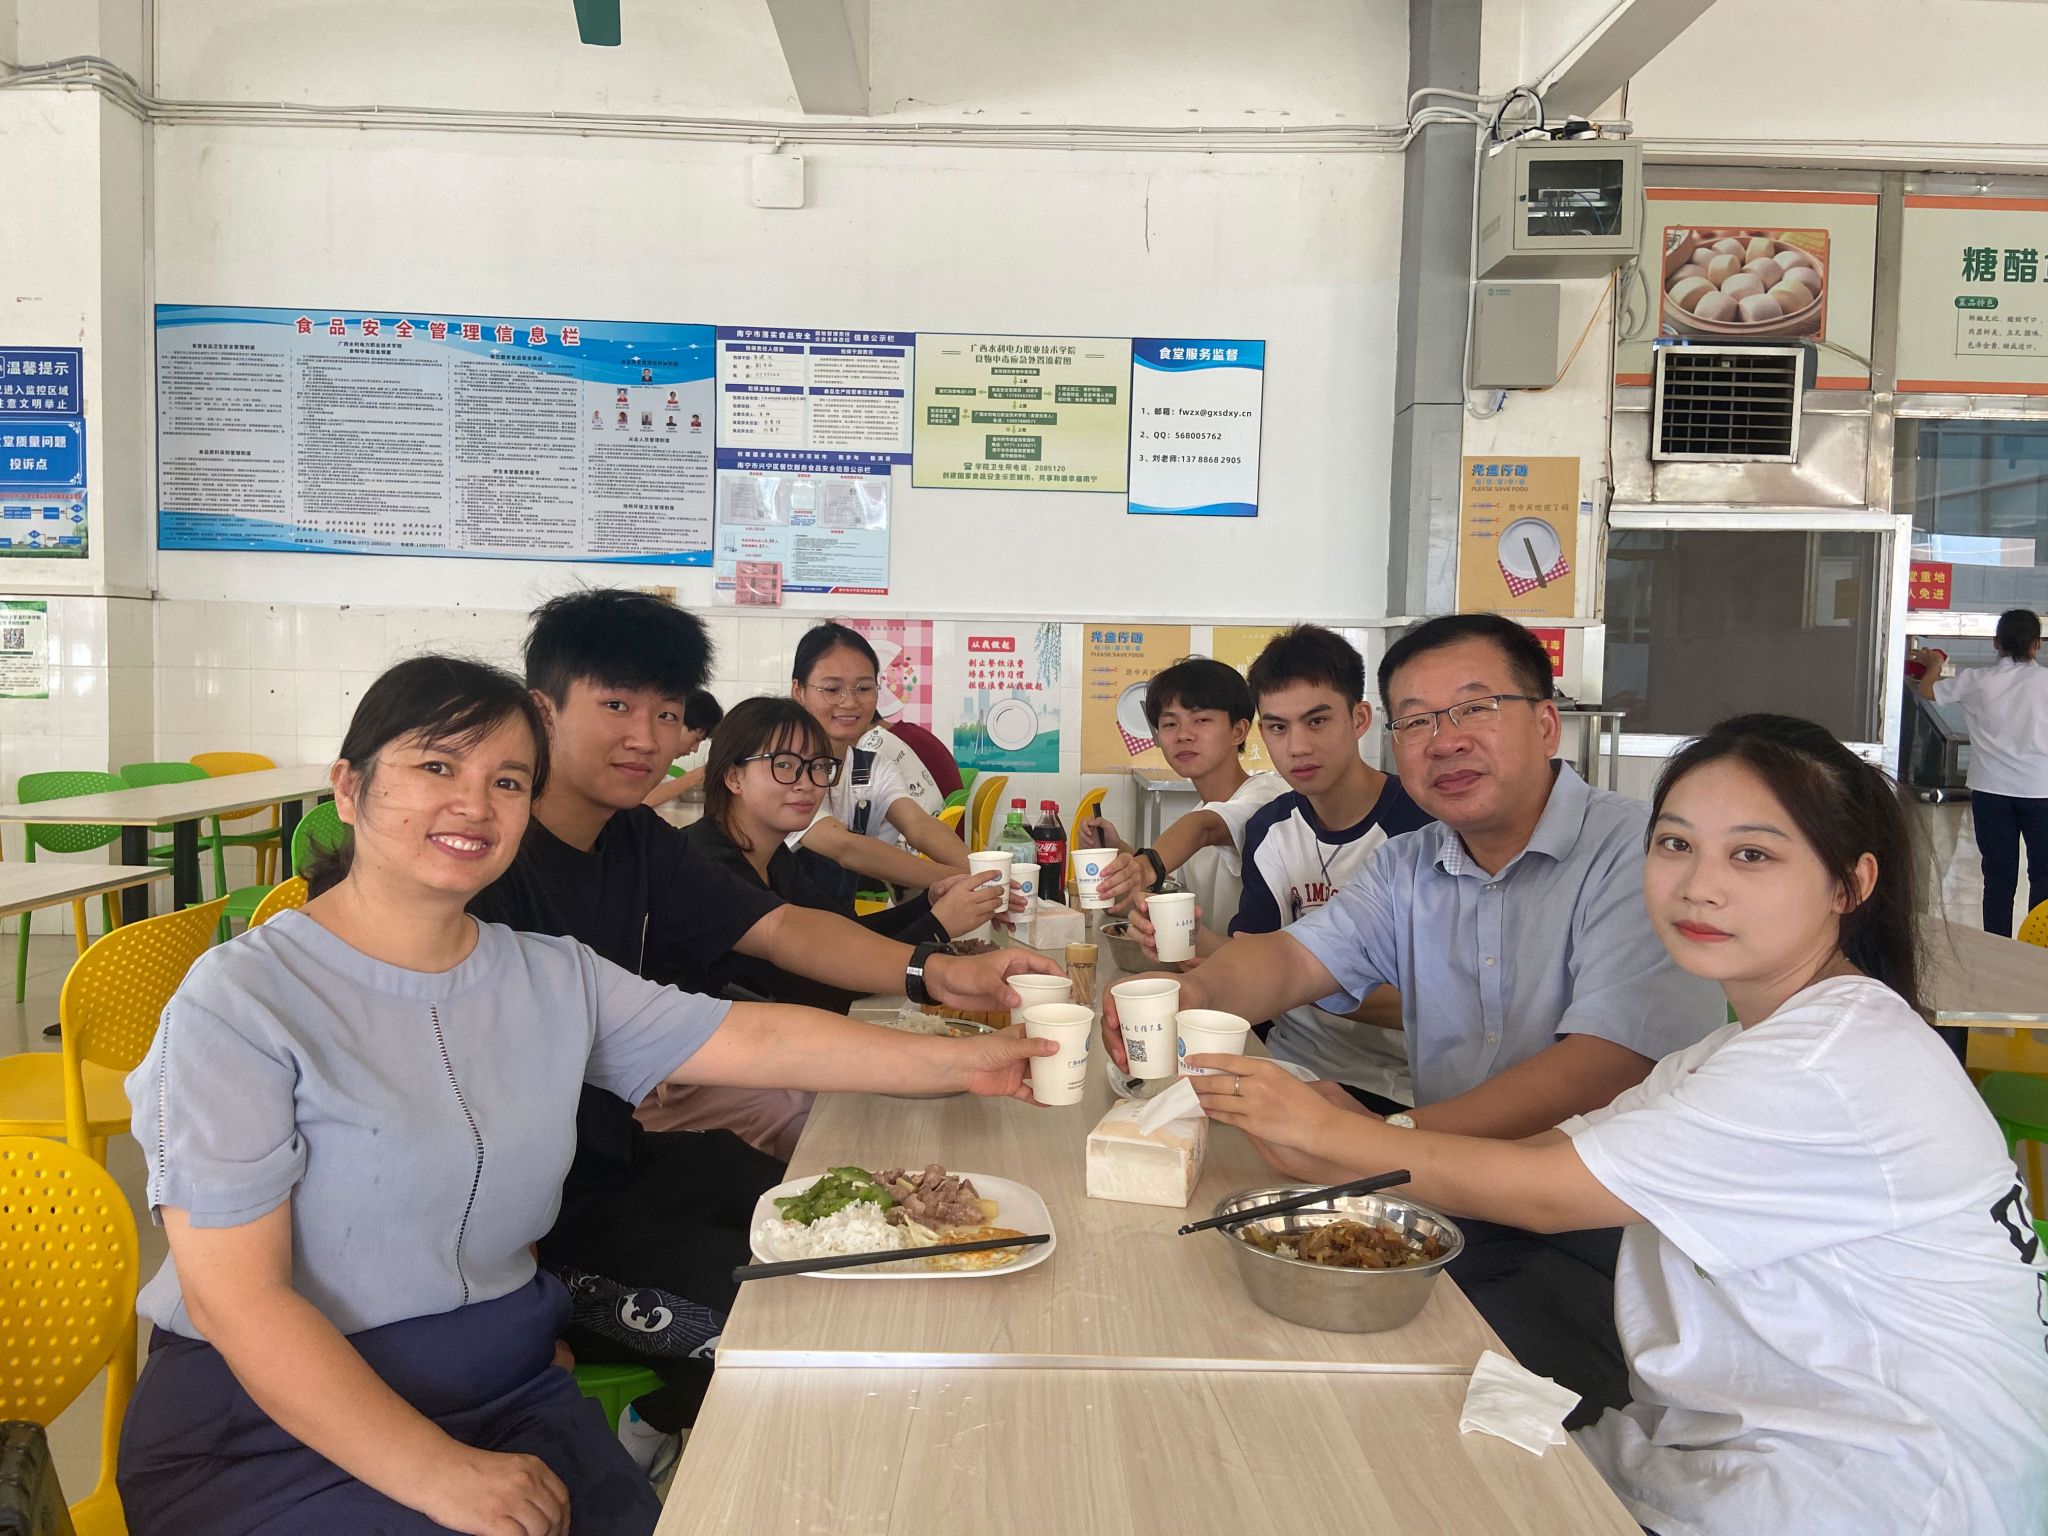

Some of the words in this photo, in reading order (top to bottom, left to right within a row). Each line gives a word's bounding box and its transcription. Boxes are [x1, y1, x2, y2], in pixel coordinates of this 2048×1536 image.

[1962, 247, 2048, 282] 糖醋
[1958, 298, 1995, 308] 菜品特色
[296, 317, 580, 346] 食品安全管理信息栏
[736, 330, 811, 340] 南宁市落实食品安全
[854, 333, 896, 343] 信息公示栏
[970, 343, 1076, 355] 广西水利电力职业技术学院
[1159, 346, 1239, 361] 食堂服务监督
[975, 354, 1072, 366] 食物中毒应急处置流程图
[7, 361, 69, 376] 温馨提示
[0, 385, 69, 396] 进入监控区域
[0, 435, 67, 448] 堂质量问题
[10, 457, 48, 471] 投诉点
[1471, 464, 1529, 477] 光盘行动
[1090, 631, 1144, 644] 光盘行动
[971, 640, 1011, 650] 从我做起
[968, 659, 1024, 669] 制止餐饮浪费
[968, 669, 1024, 679] 培养节约习惯
[968, 680, 1043, 691] 拒绝浪费从我做起
